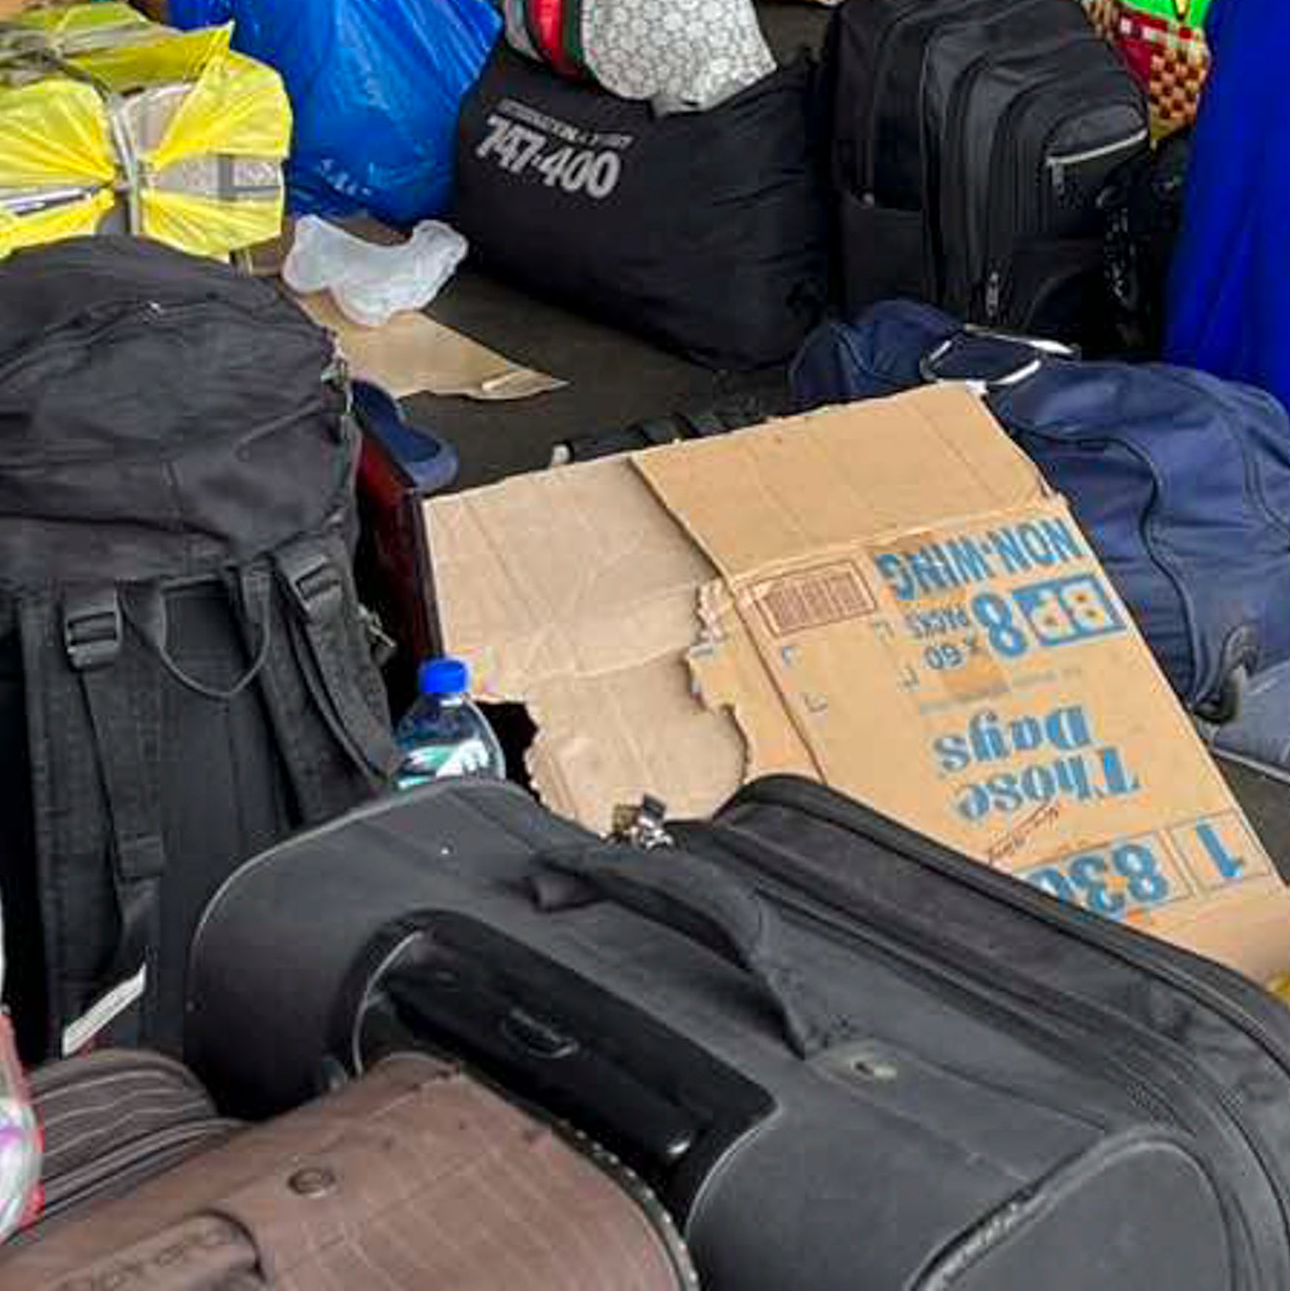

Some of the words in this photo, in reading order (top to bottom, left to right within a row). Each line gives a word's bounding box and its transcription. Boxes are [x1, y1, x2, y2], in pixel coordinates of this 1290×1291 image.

[475, 114, 621, 199] 747-400
[874, 516, 1088, 601] NON-WING
[970, 590, 1030, 657] 8
[933, 706, 1094, 775] Days
[956, 745, 1142, 822] Those
[1194, 815, 1245, 879] 1
